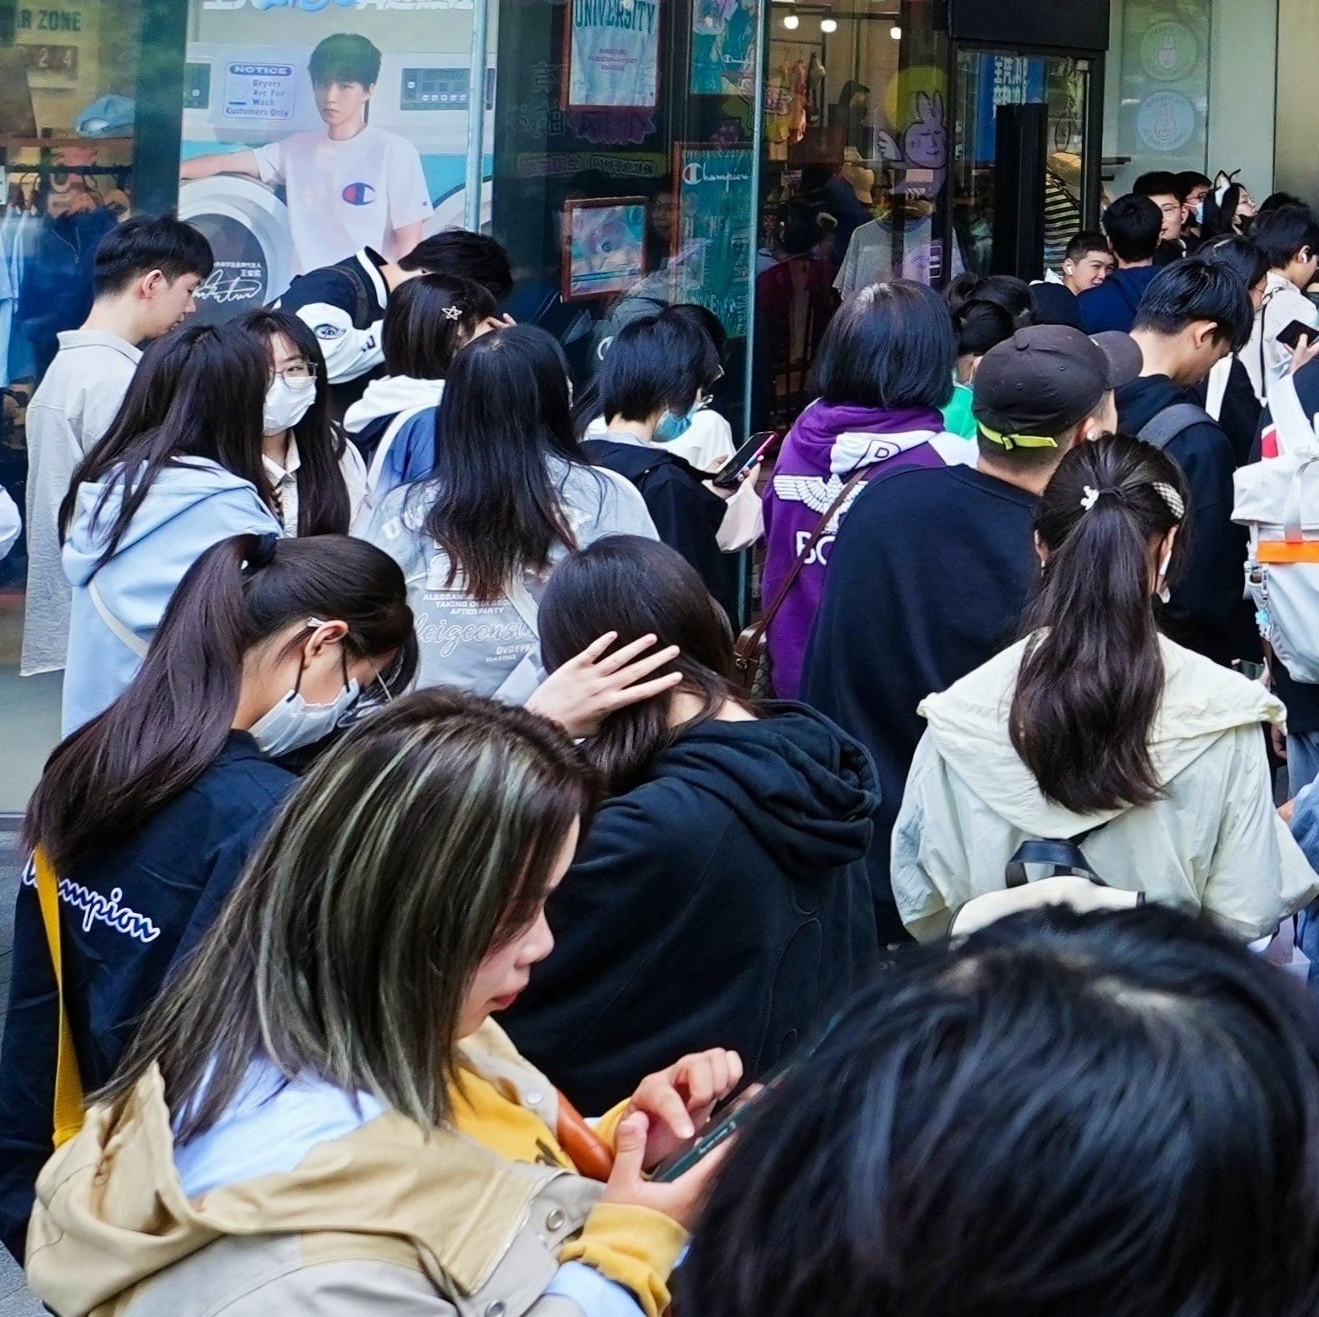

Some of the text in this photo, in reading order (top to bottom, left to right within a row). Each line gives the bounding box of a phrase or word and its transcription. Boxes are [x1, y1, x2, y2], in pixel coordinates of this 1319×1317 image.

[233, 65, 289, 75] NOTICE
[252, 79, 282, 89] Dryers
[226, 107, 268, 117] Customers
[683, 162, 750, 192] Champion
